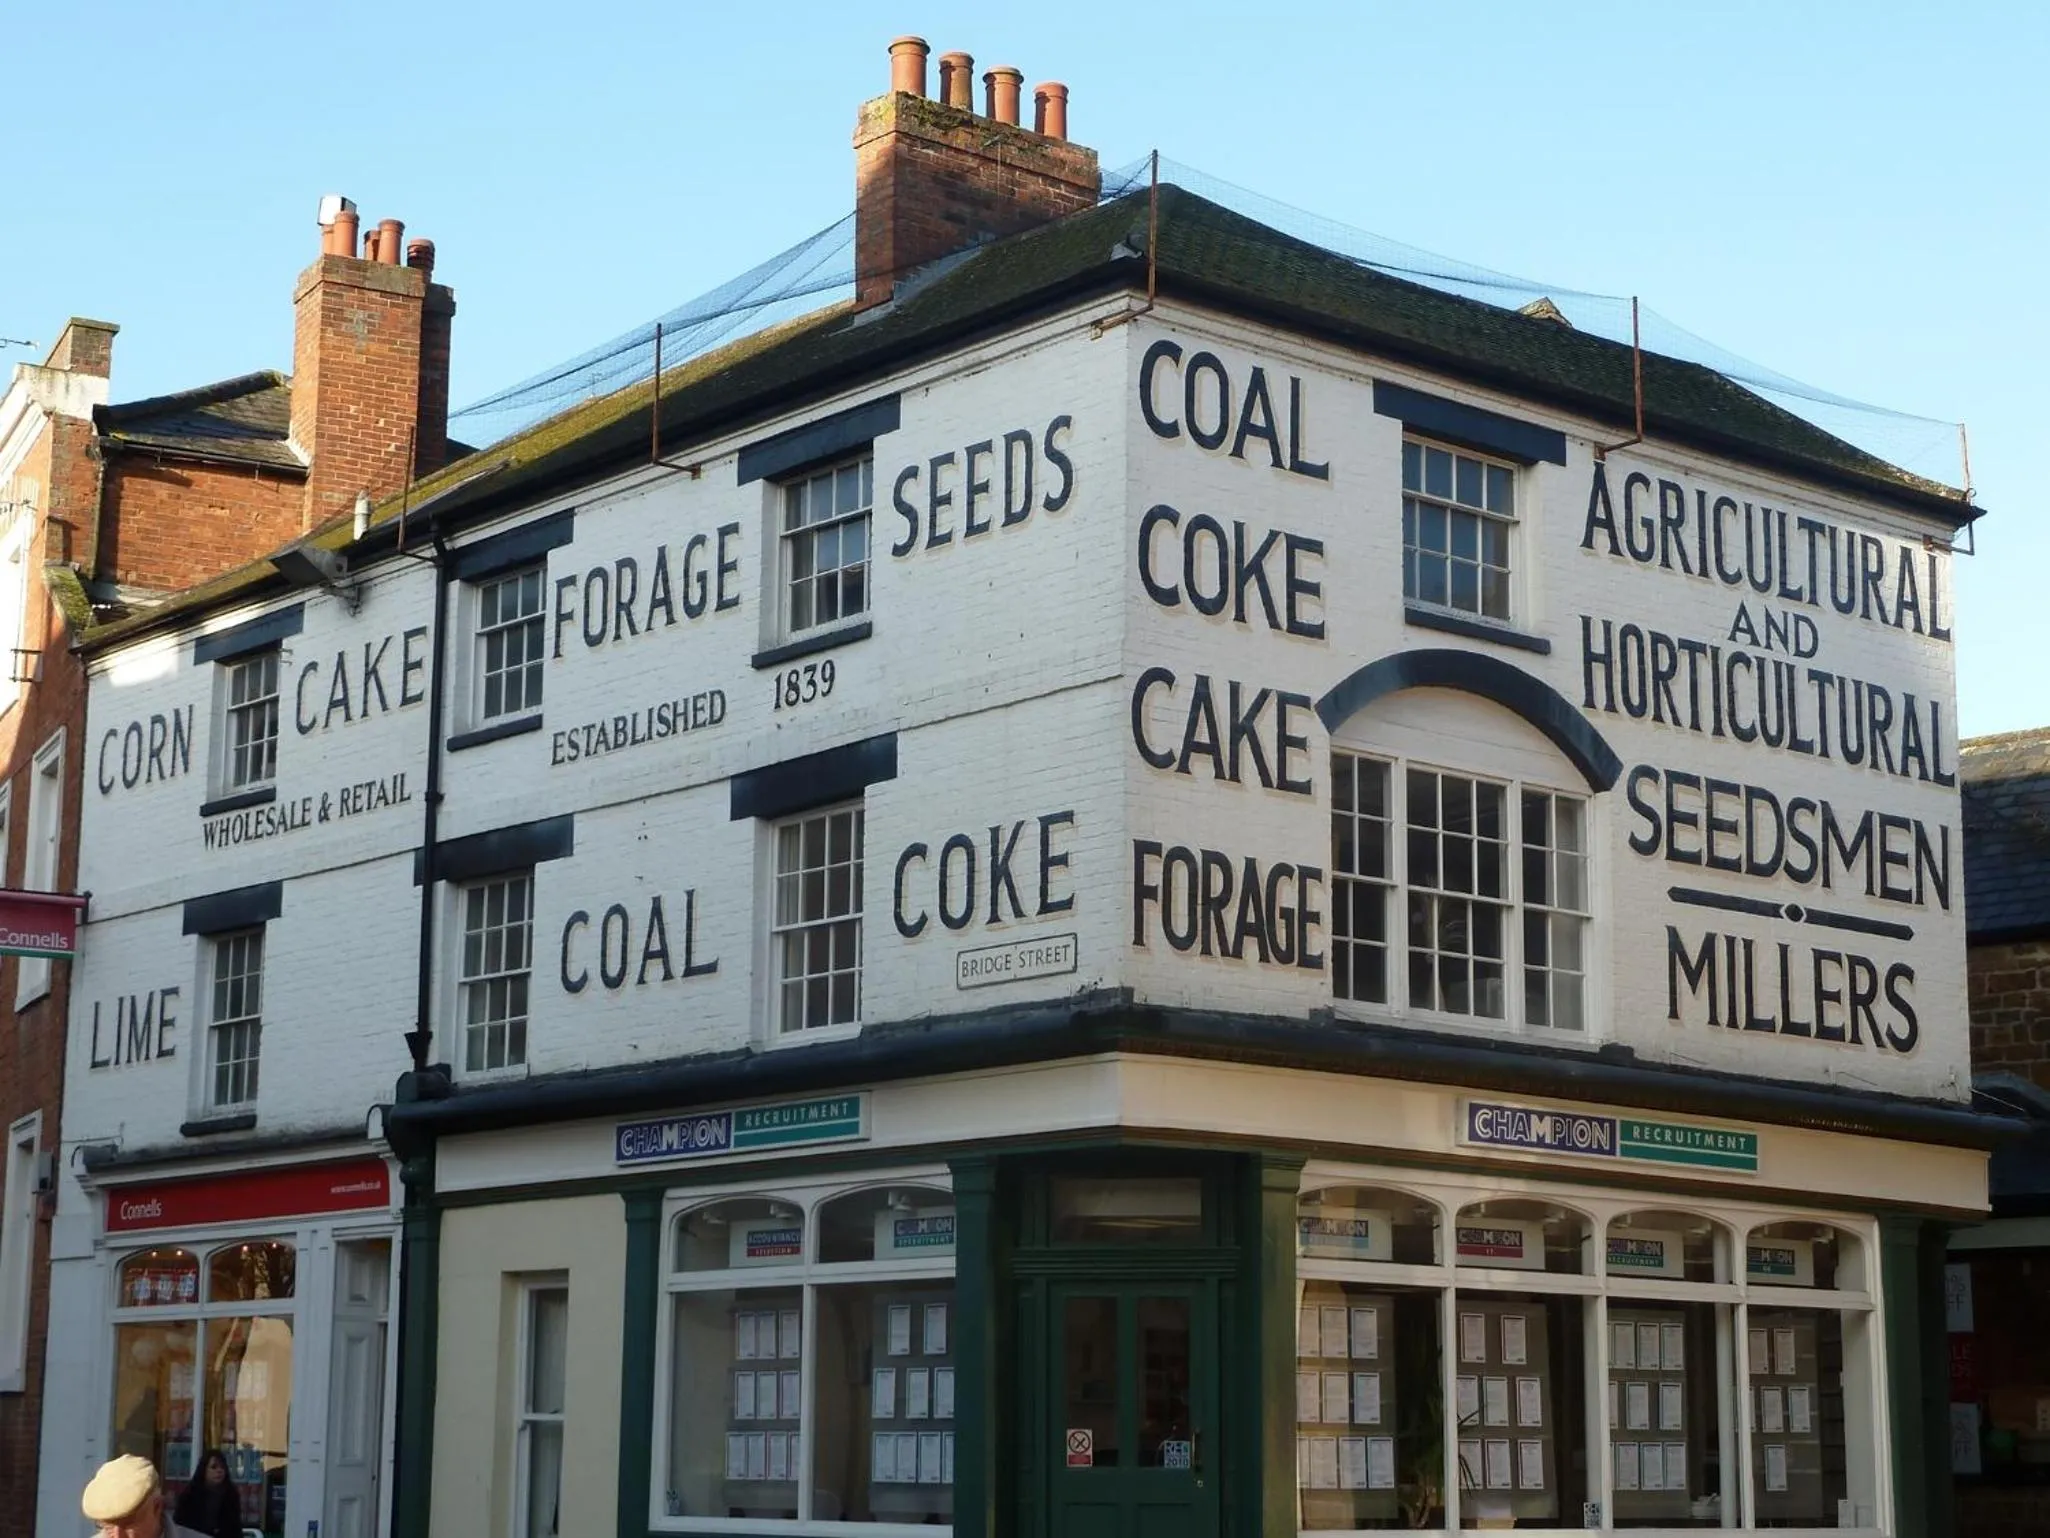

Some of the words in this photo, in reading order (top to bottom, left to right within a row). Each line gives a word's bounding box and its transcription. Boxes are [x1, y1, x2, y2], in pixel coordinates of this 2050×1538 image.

[1138, 339, 1330, 480] COAL
[891, 415, 1074, 558] SEEDS
[554, 521, 741, 659] FORAGE
[1138, 504, 1325, 640] COKE
[1581, 460, 1952, 642] AGRICULTURAL
[297, 626, 428, 735] CAKE
[1728, 600, 1819, 658] AND
[98, 705, 194, 795] CORN
[551, 689, 726, 766] ESTABLISHED
[774, 659, 836, 710] 1839
[1131, 666, 1312, 795] CAKE
[1580, 614, 1955, 788] HORTICULTURAL
[203, 796, 312, 850] WHOLESALE
[317, 792, 332, 822] &
[339, 772, 411, 818] RETAIL
[1626, 763, 1950, 912] SEEDSMEN
[892, 810, 1075, 938] COKE
[1132, 838, 1324, 970] FORAGE
[0, 927, 68, 949] Connells
[560, 888, 719, 994] COAL
[961, 954, 1012, 978] BRIDGE
[1019, 944, 1071, 968] STREET
[1666, 925, 1919, 1053] MILLERS
[90, 986, 180, 1069] LIME
[620, 1118, 726, 1156] CHAMPION
[745, 1102, 849, 1127] RECRUITMENT
[1474, 1108, 1609, 1149] CHAMPION
[1632, 1125, 1747, 1150] RECRUITMENT
[120, 1198, 162, 1221] Connells
